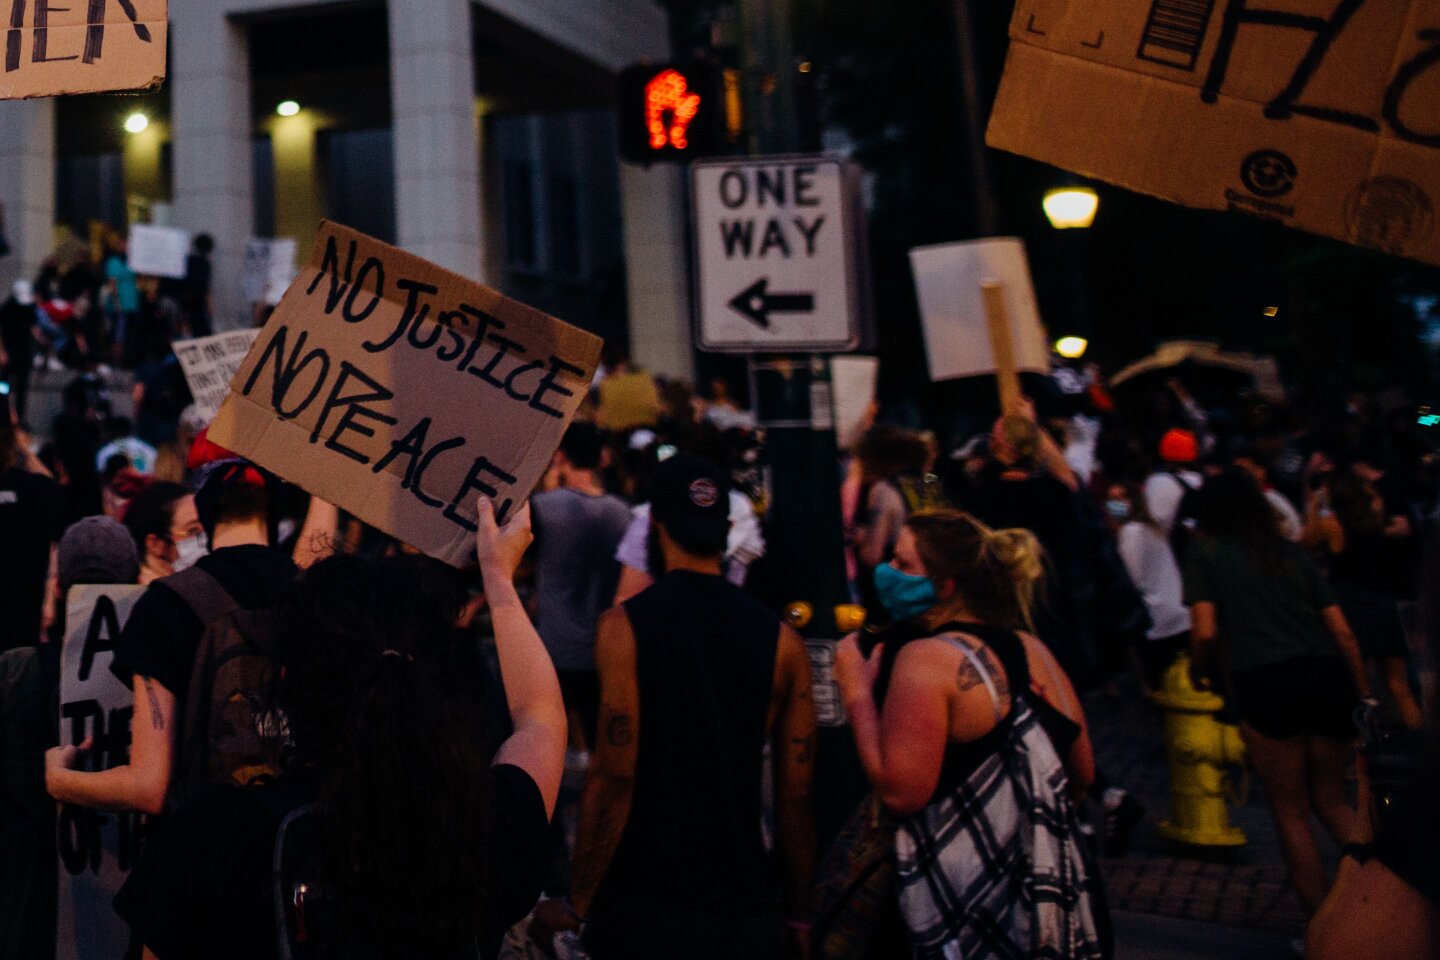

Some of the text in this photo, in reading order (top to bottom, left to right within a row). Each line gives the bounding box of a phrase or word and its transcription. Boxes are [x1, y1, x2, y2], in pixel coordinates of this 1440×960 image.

[719, 167, 821, 209] ONE
[719, 217, 824, 260] WAY
[307, 236, 384, 323] NO
[363, 279, 585, 418] JUSTICE
[242, 326, 331, 421] NO
